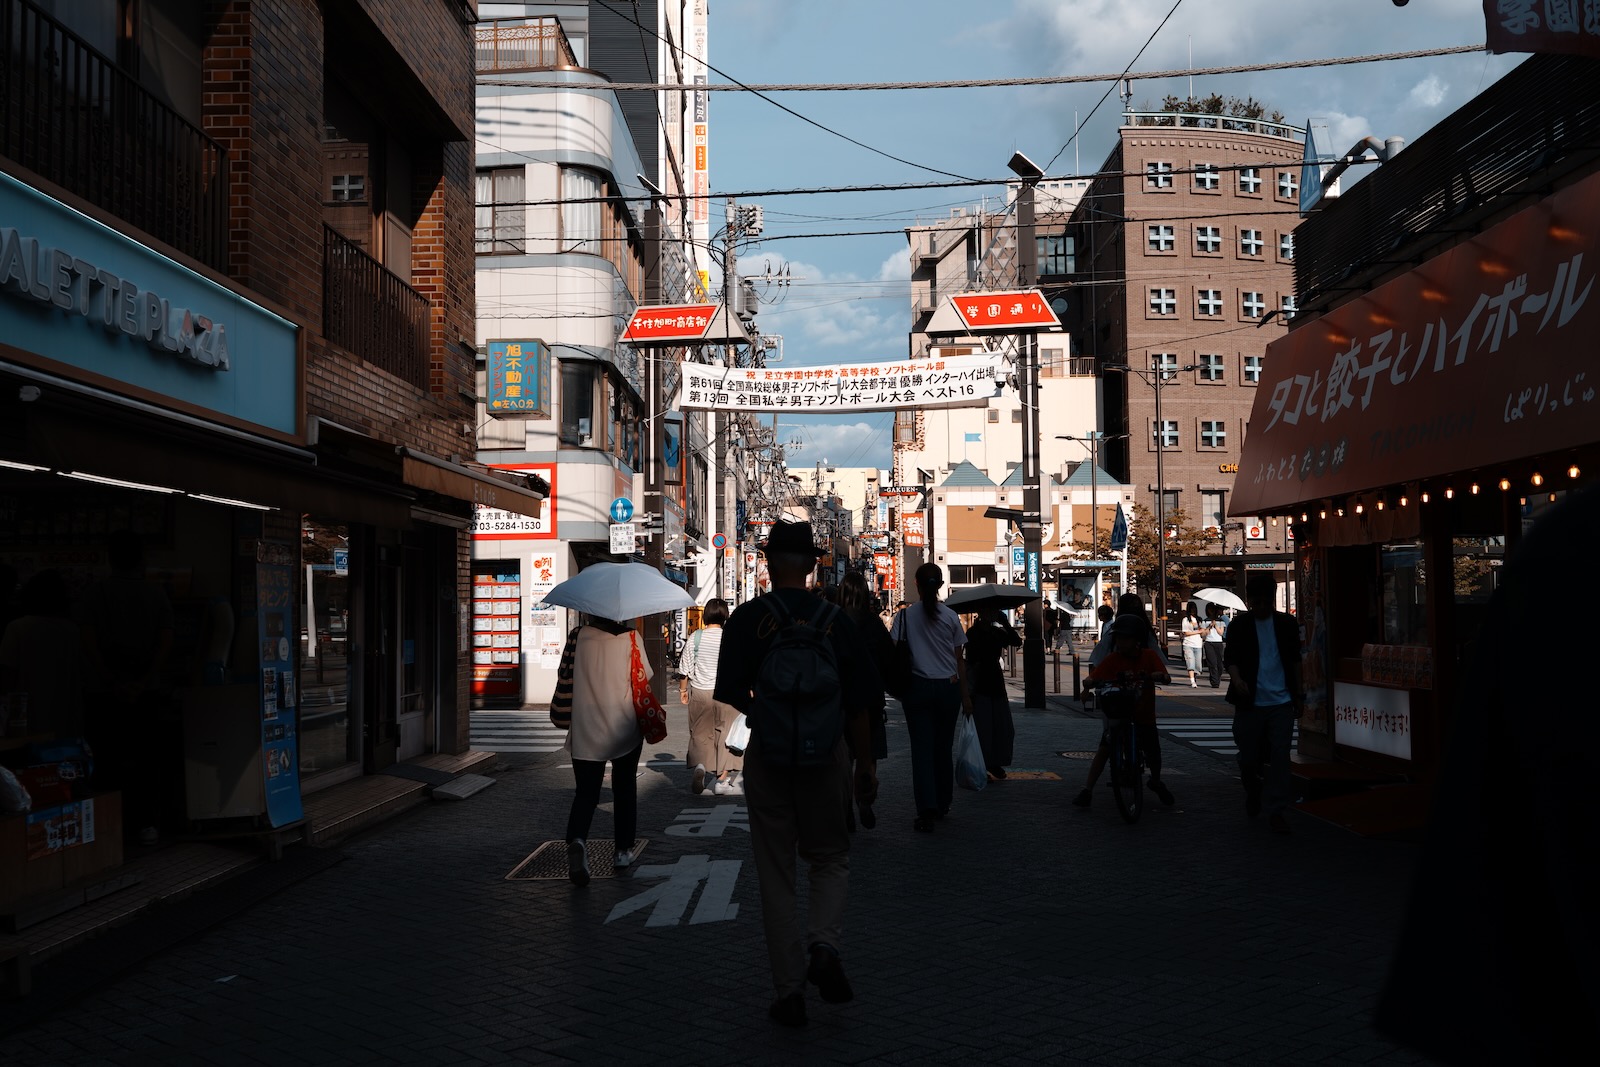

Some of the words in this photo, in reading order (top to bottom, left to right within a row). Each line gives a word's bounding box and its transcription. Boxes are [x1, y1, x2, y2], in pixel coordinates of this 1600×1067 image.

[696, 105, 704, 121] TBC
[0, 228, 139, 335] ALETTE
[145, 291, 229, 372] PLAZA
[967, 302, 1042, 318] 学園通り
[633, 315, 707, 330] 千住旭町商店街
[1263, 253, 1596, 434] タコと餃子とハイボール
[493, 352, 503, 398] マンション
[506, 344, 522, 397] 旭不動産
[524, 352, 534, 396] アパート
[690, 376, 723, 390] 第61回
[727, 377, 898, 393] 全国高校総体男子ソフトボール大会都予選
[900, 375, 923, 388] 優勝
[925, 366, 995, 384] インターハイ出場
[746, 370, 756, 380] 祝
[764, 367, 880, 381] 足立学園中学校・高等学校
[884, 361, 945, 376] ソフトボール部
[689, 391, 729, 405] 第13回
[736, 390, 916, 407] 全国私学男子ソフトボール大会
[474, 483, 496, 505] Etude
[479, 521, 541, 531] 03-5284-1530
[540, 557, 553, 582] 例祭
